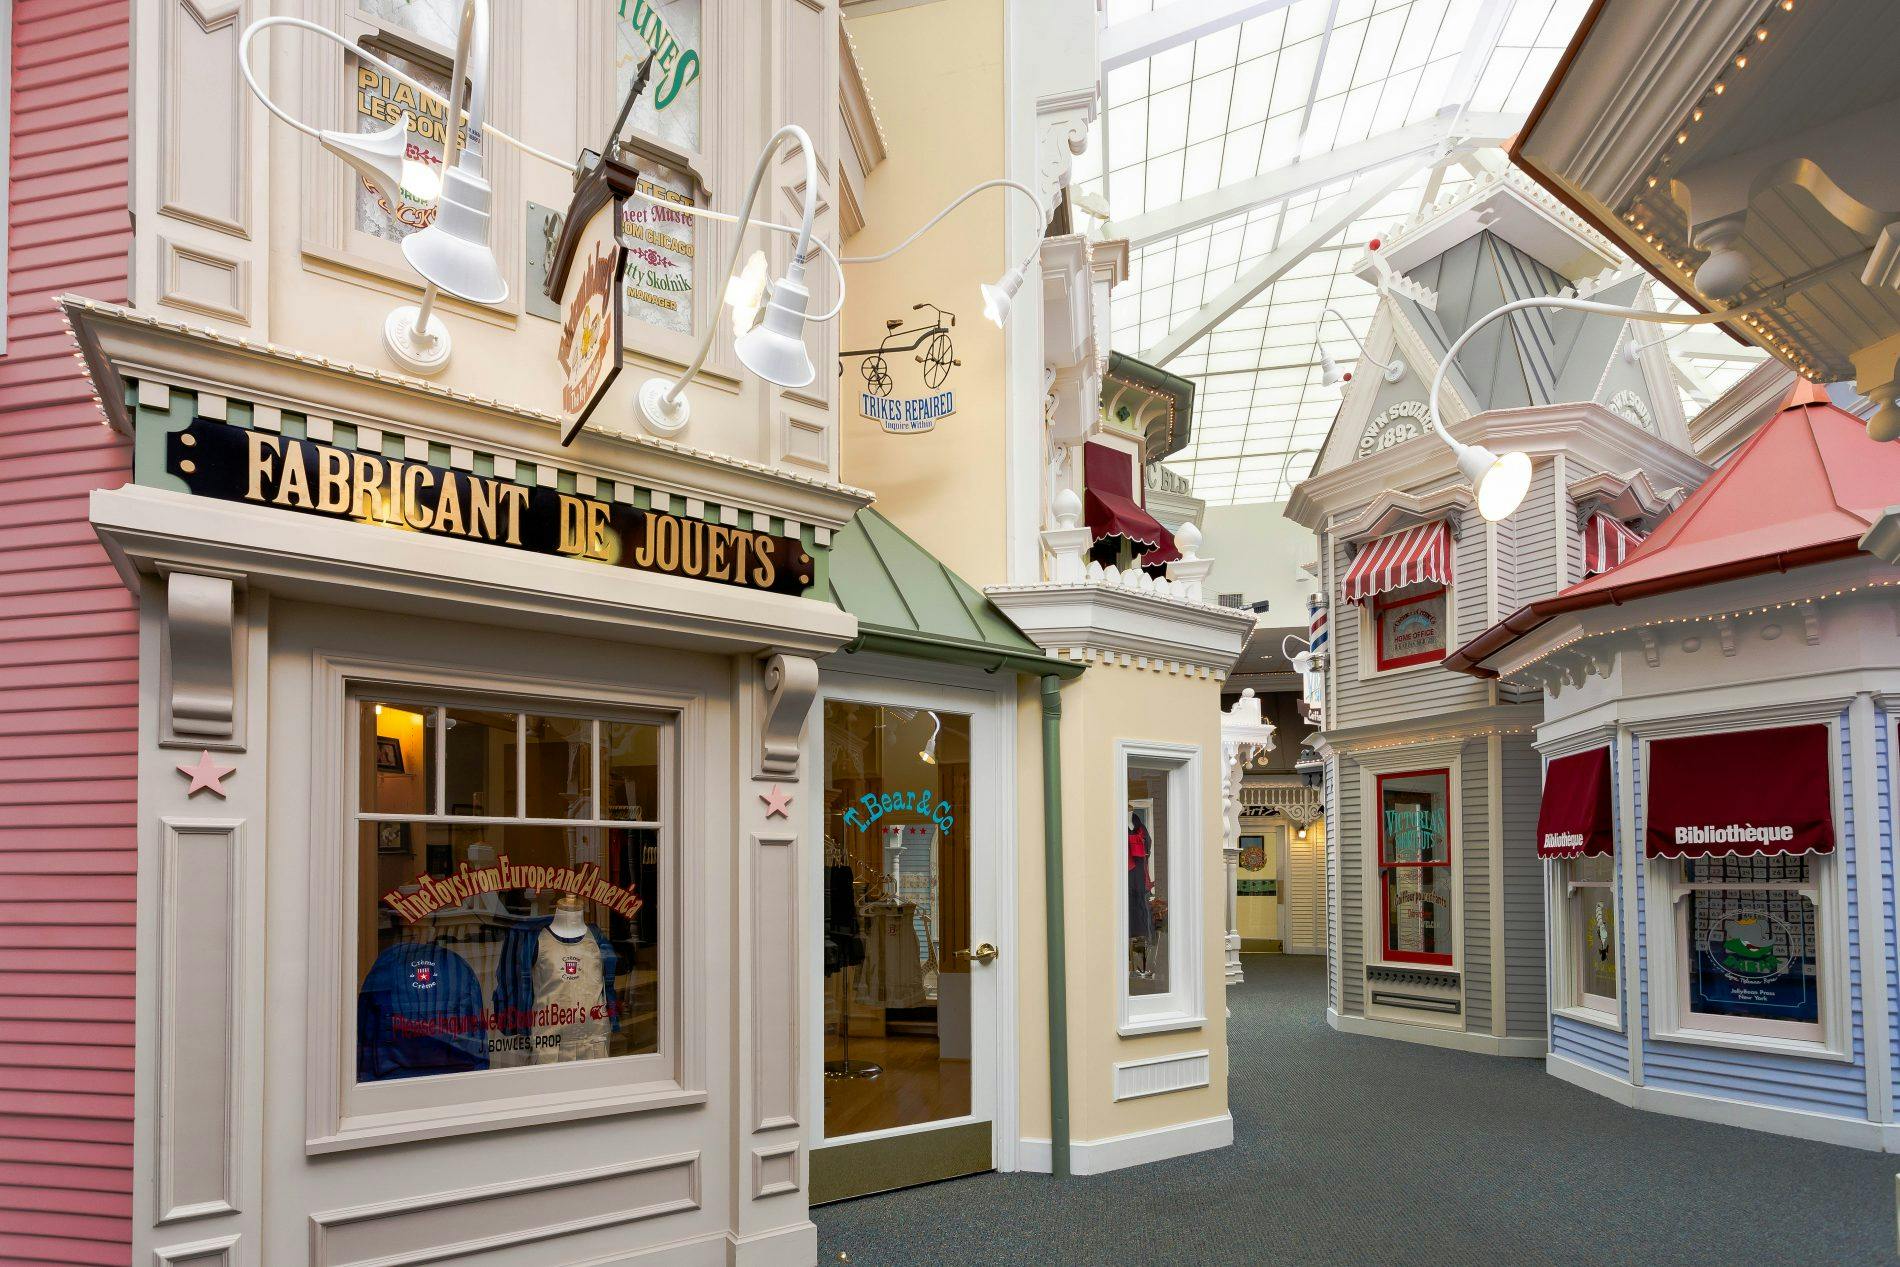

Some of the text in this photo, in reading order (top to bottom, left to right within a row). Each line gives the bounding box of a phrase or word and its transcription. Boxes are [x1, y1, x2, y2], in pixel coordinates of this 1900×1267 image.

[646, 269, 692, 292] Skolnik
[627, 286, 678, 312] MANAGER
[862, 391, 953, 421] TRIKES REPAIRED
[1388, 400, 1435, 435] SQUARE
[885, 420, 933, 431] Inquire Within
[1375, 423, 1420, 452] 1892
[244, 430, 776, 589] FABRICANT DE JOUETS
[1412, 628, 1435, 640] OFFICE
[860, 790, 917, 824] Bear
[916, 788, 933, 817] &
[1543, 830, 1584, 850] Bibliothèque
[1674, 822, 1795, 846] Bibliothèque
[382, 852, 644, 925] Fine Toys from Europe and America
[538, 1006, 551, 1027] at
[550, 1001, 587, 1027] Bear's
[488, 1036, 534, 1053] BOWLES,
[535, 1034, 561, 1049] PROP.
